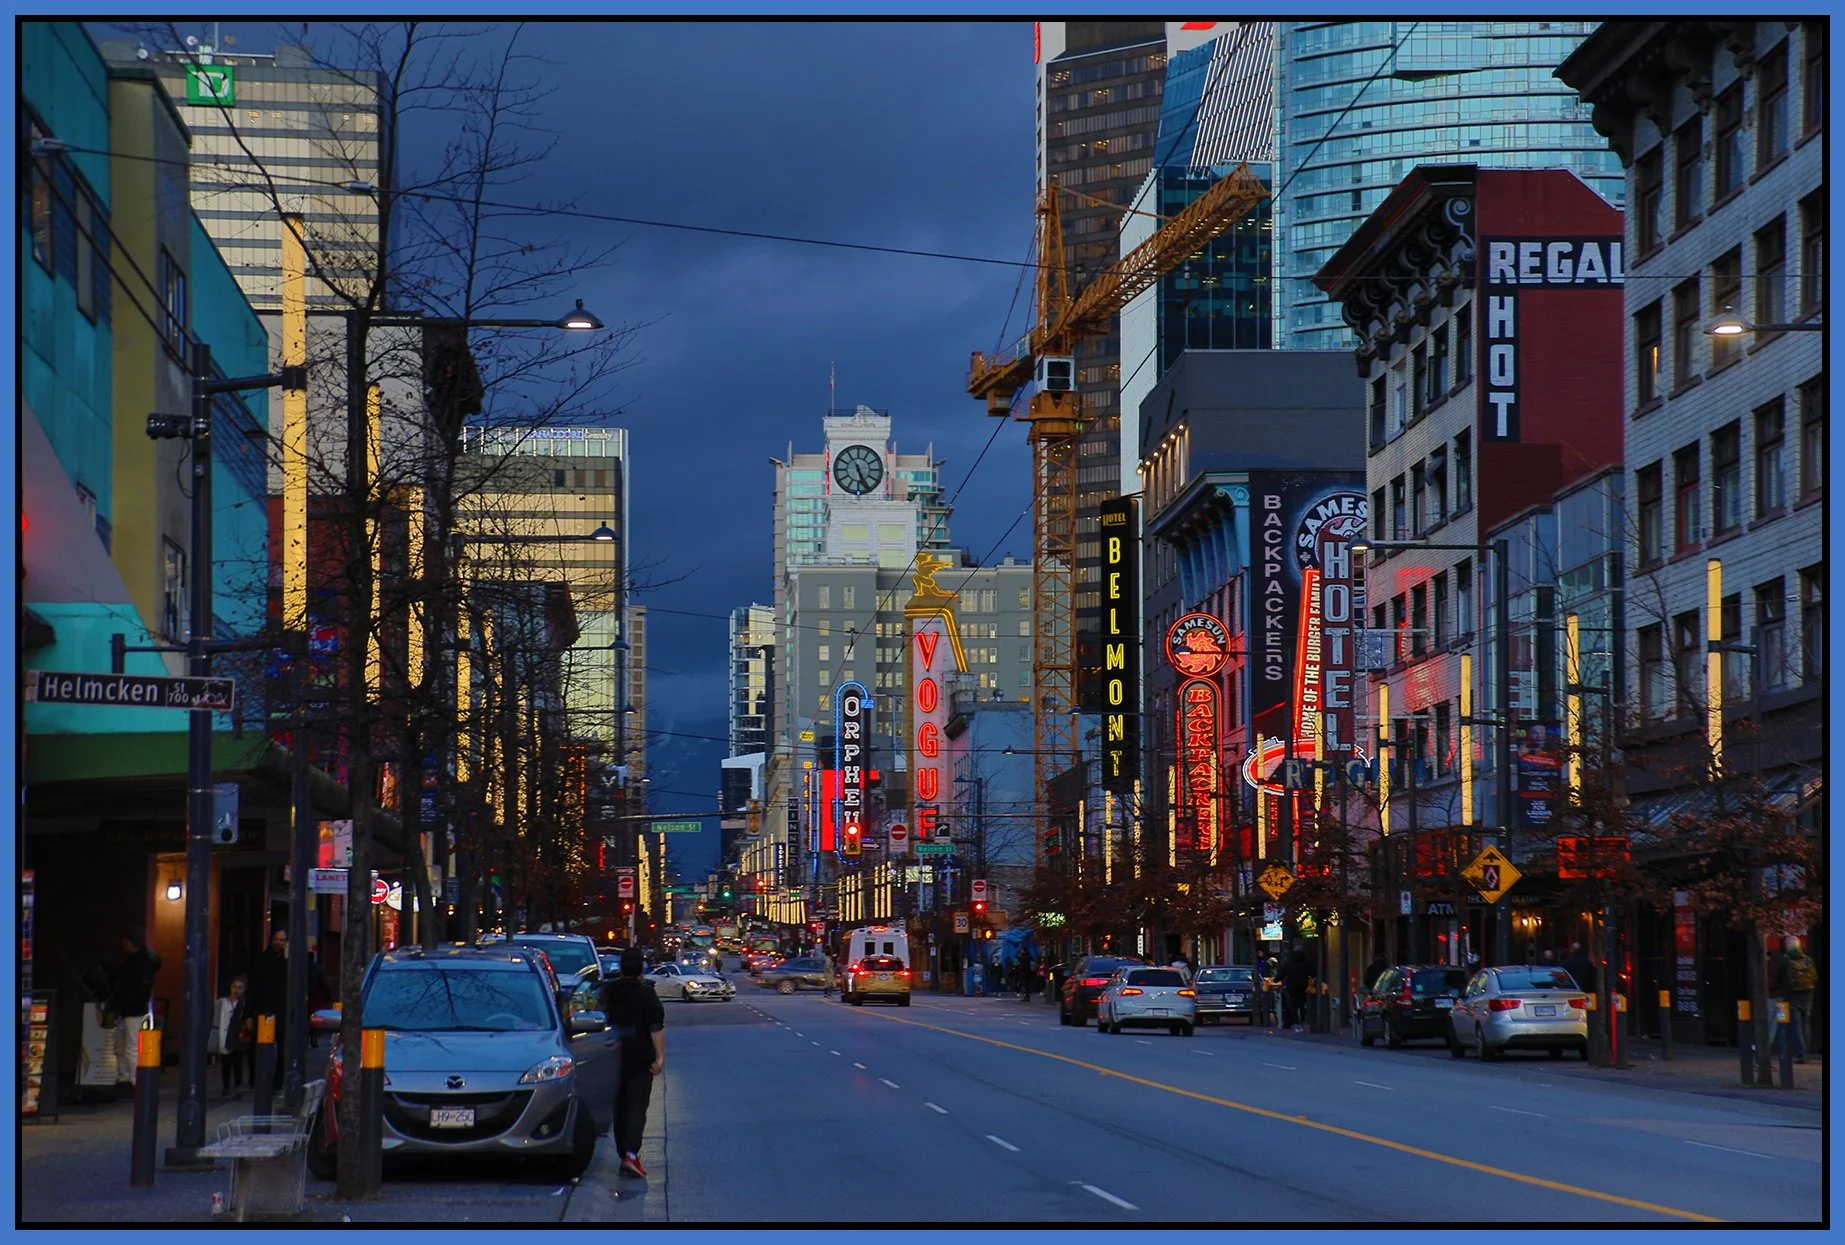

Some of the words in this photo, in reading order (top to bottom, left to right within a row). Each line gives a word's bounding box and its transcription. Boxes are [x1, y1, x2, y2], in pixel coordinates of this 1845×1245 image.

[1489, 241, 1624, 285] REGAL
[1489, 296, 1515, 437] HOT
[1103, 512, 1126, 526] HOTEL
[1263, 494, 1285, 682] BACKPACKERS
[1172, 617, 1227, 646] SAMESUN
[1106, 536, 1125, 777] BELMONT
[1323, 541, 1352, 751] HOTEL
[1304, 663, 1320, 686] THE
[43, 675, 159, 703] Helmcken
[173, 681, 185, 693] St
[168, 691, 190, 704] 700
[1303, 687, 1318, 702] OF
[956, 918, 967, 928] 30
[1427, 903, 1457, 915] ATM
